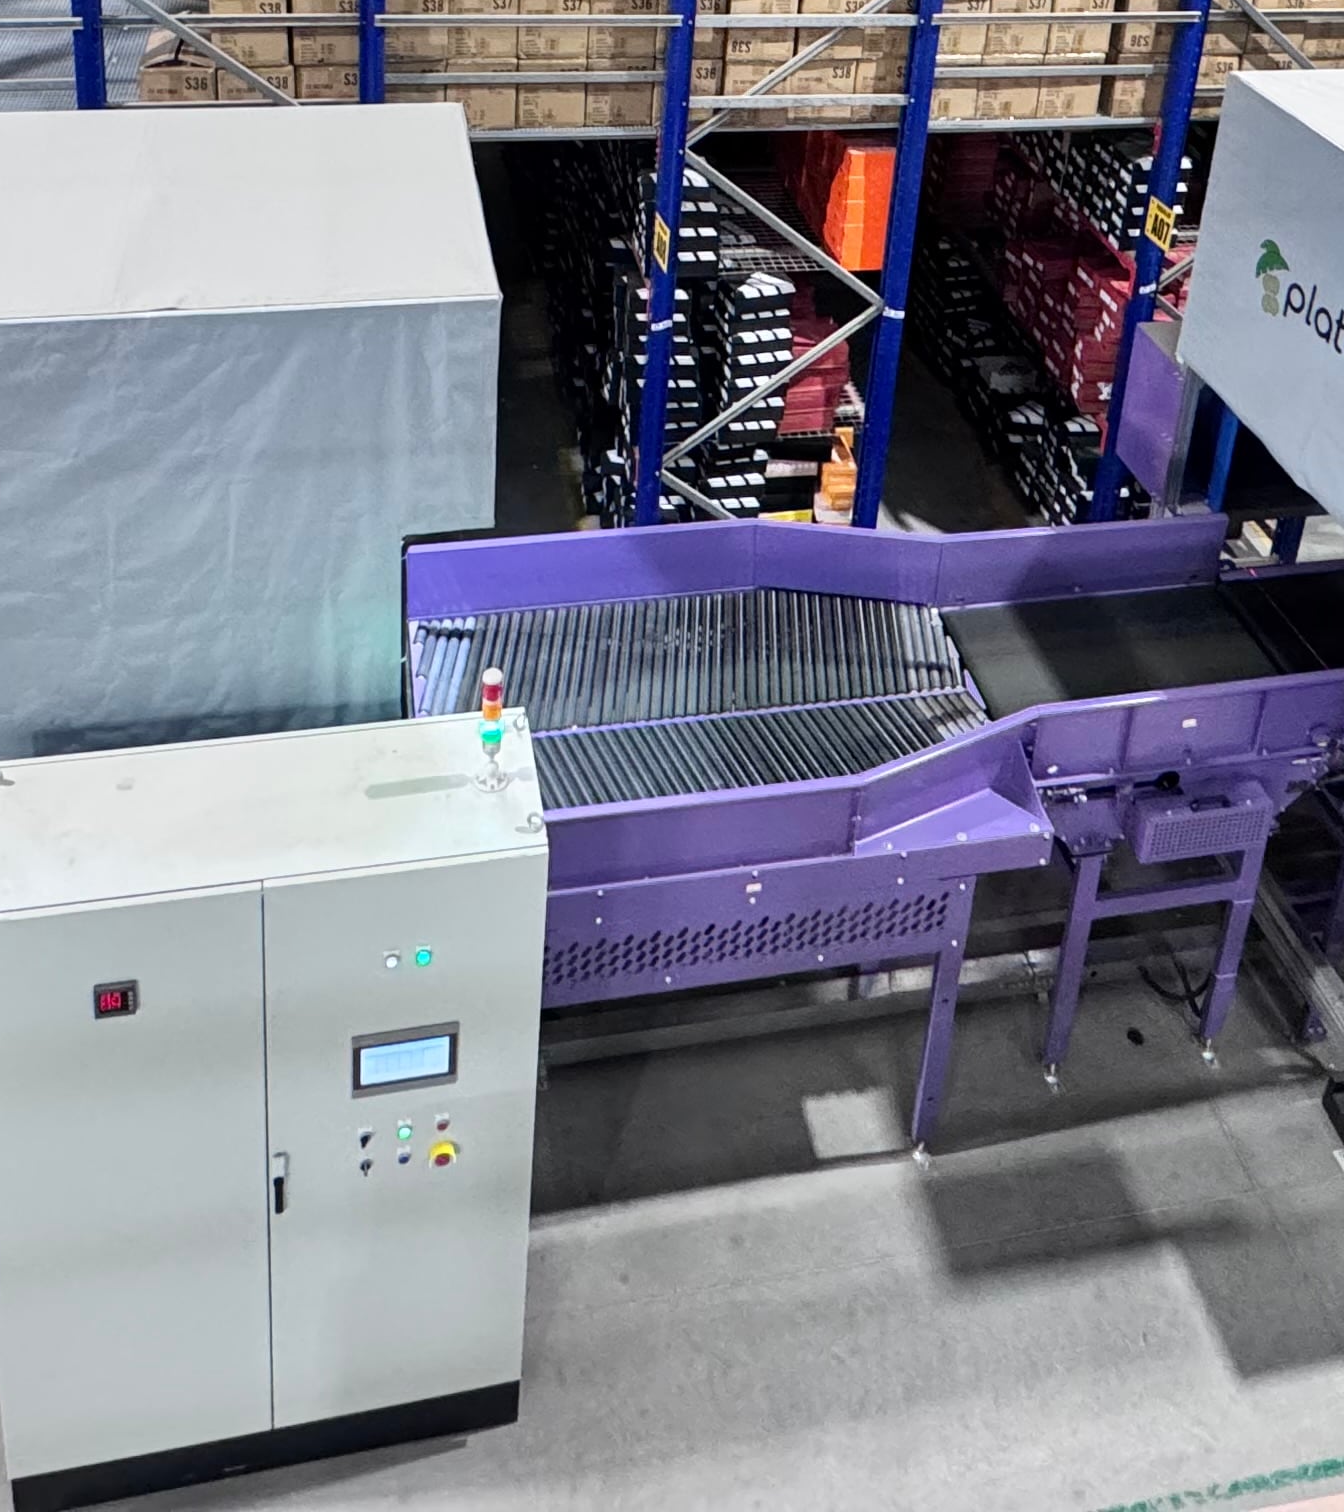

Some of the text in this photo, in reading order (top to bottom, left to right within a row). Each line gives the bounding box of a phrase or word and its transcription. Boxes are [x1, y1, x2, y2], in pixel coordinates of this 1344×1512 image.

[421, 0, 444, 13] S38
[967, 0, 986, 11] S37
[184, 76, 208, 90] S36
[1151, 213, 1170, 245] A07
